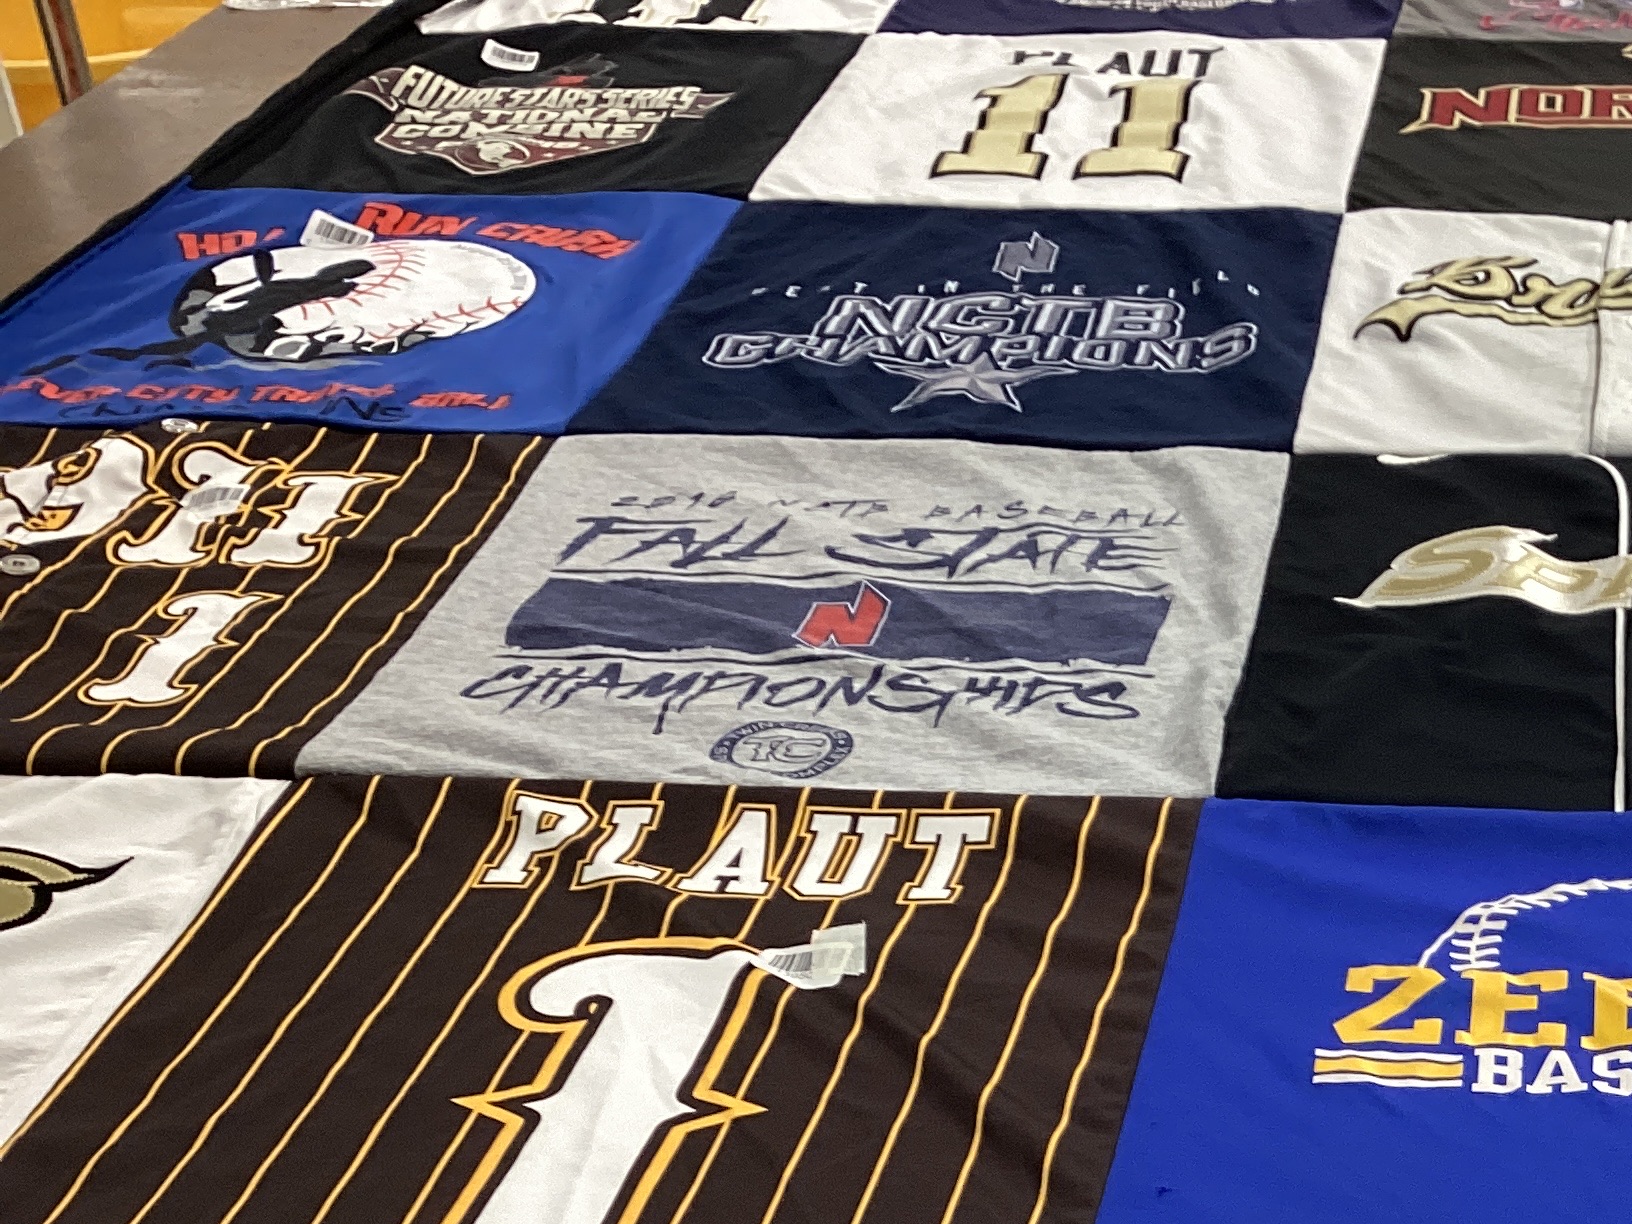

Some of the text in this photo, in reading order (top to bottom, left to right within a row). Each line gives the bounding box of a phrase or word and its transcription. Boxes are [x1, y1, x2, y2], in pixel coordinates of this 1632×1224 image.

[391, 64, 503, 109] FUTURE
[928, 74, 1197, 182] 11
[352, 201, 479, 238] RUN
[702, 322, 1260, 373] CHAMPIONS
[819, 296, 1184, 342] NCTB
[923, 500, 1185, 528] BASEBALL
[554, 516, 1180, 579] FALL STATE
[78, 588, 284, 708] 1
[459, 663, 1142, 734] CHAMPIONSHIPS
[472, 791, 1000, 904] PLAUT
